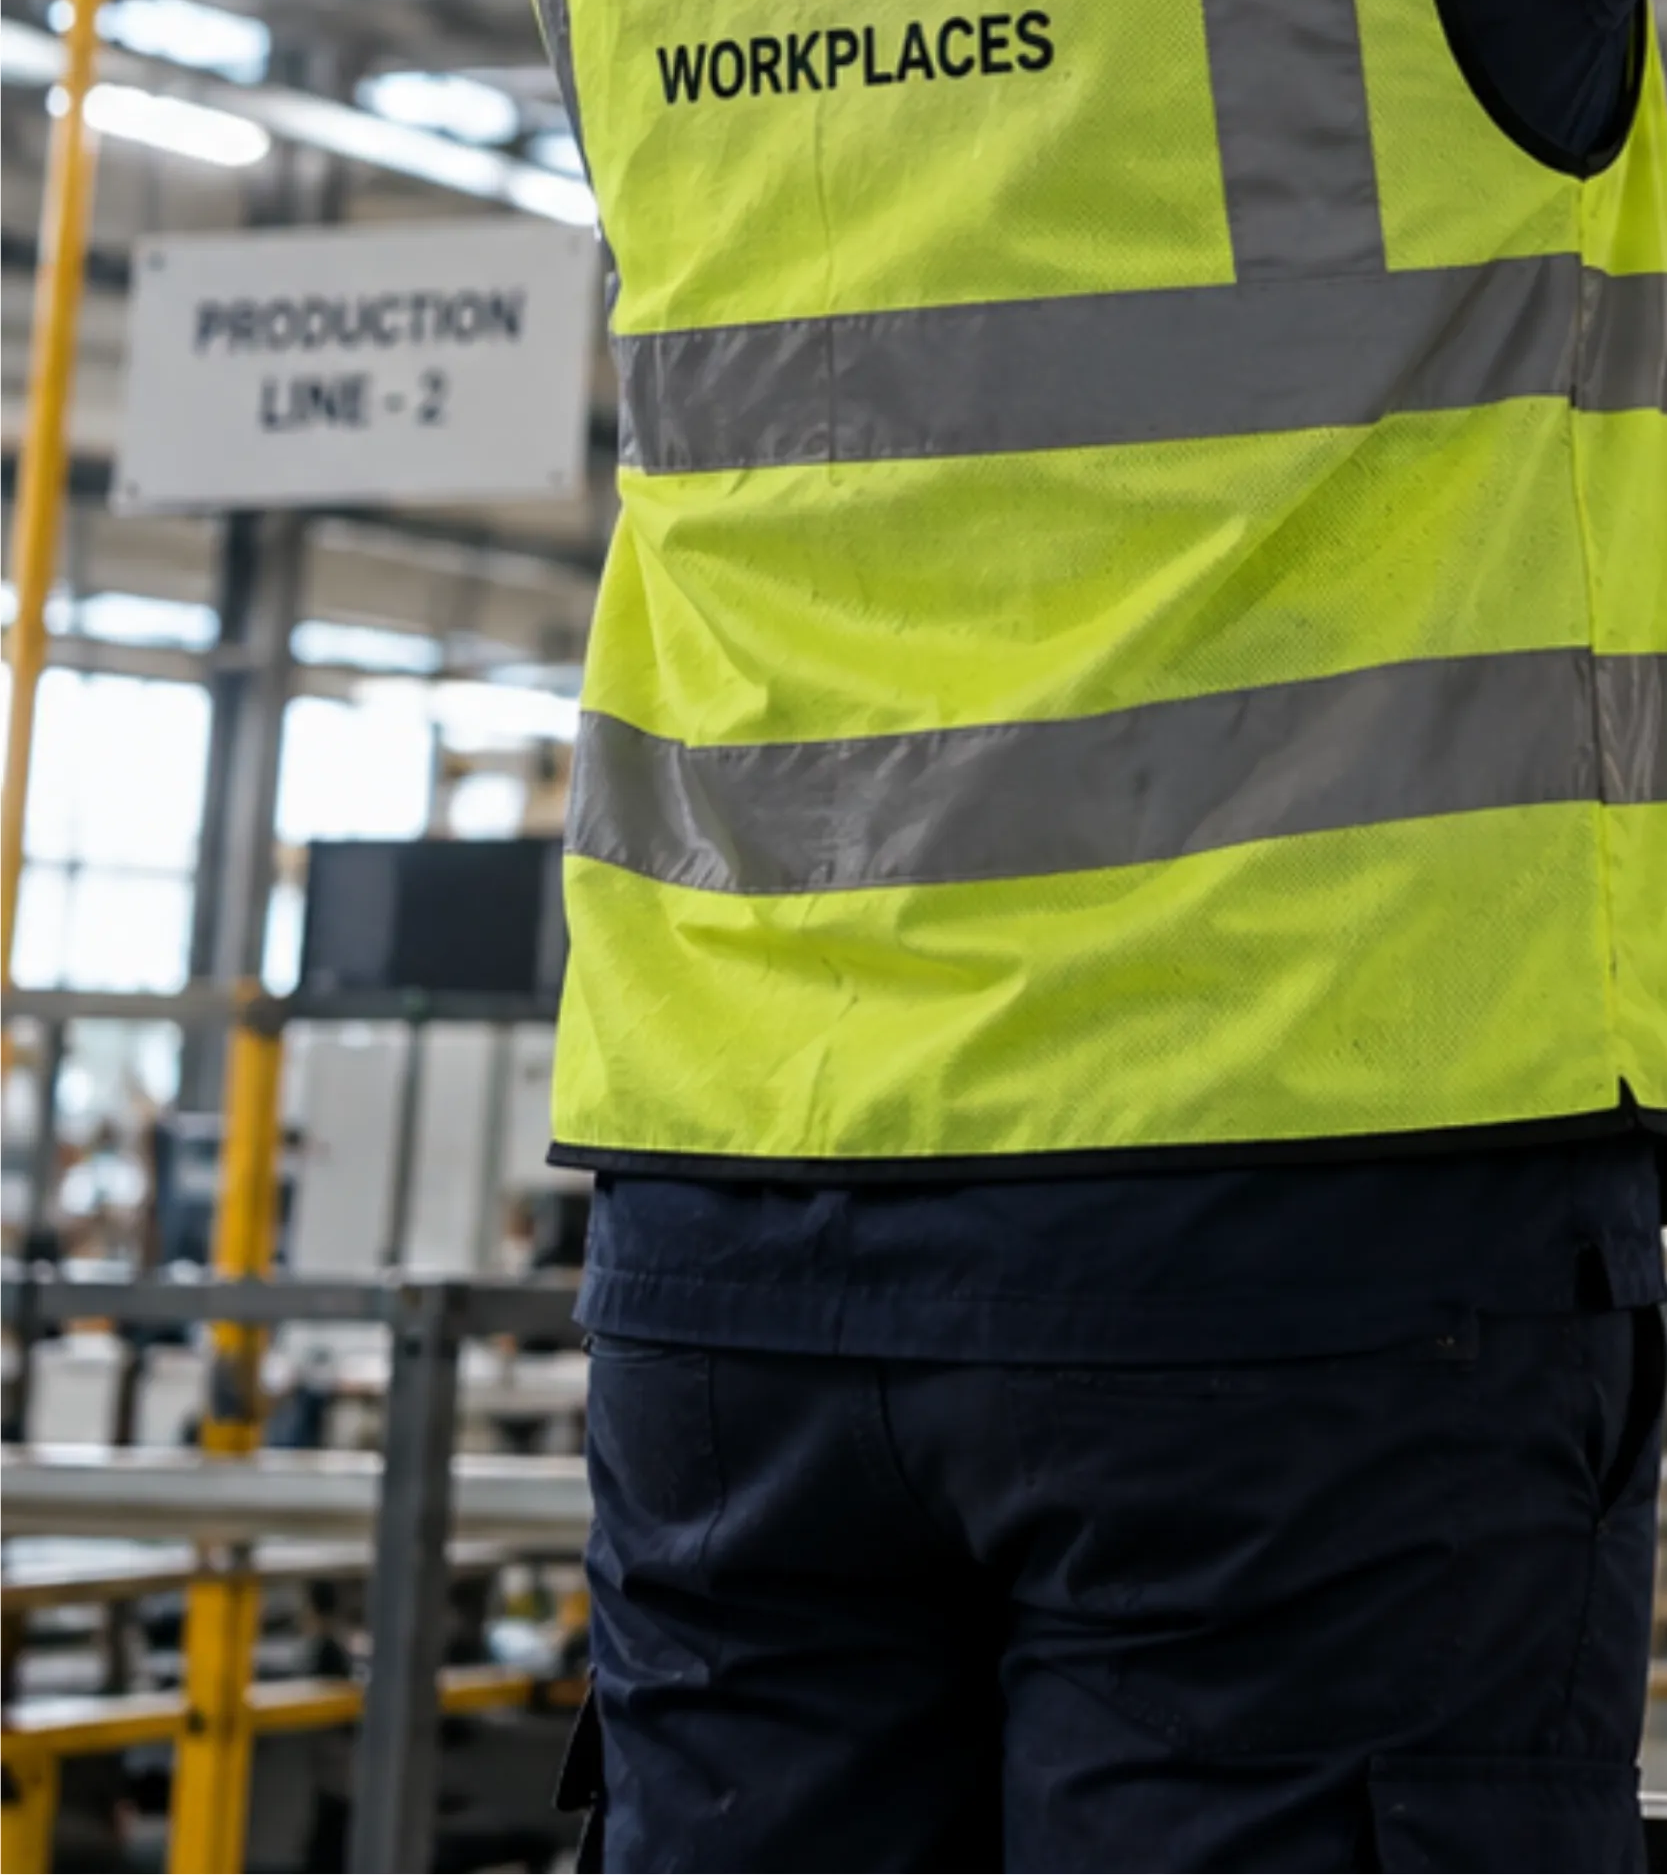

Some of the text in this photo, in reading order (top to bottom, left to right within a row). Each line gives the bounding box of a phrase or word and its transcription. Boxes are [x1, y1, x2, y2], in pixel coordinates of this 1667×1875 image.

[655, 9, 1055, 105] WORKPLACES
[192, 288, 526, 354] PRODUCTION
[259, 372, 369, 432] LINE
[416, 369, 449, 428] 2
